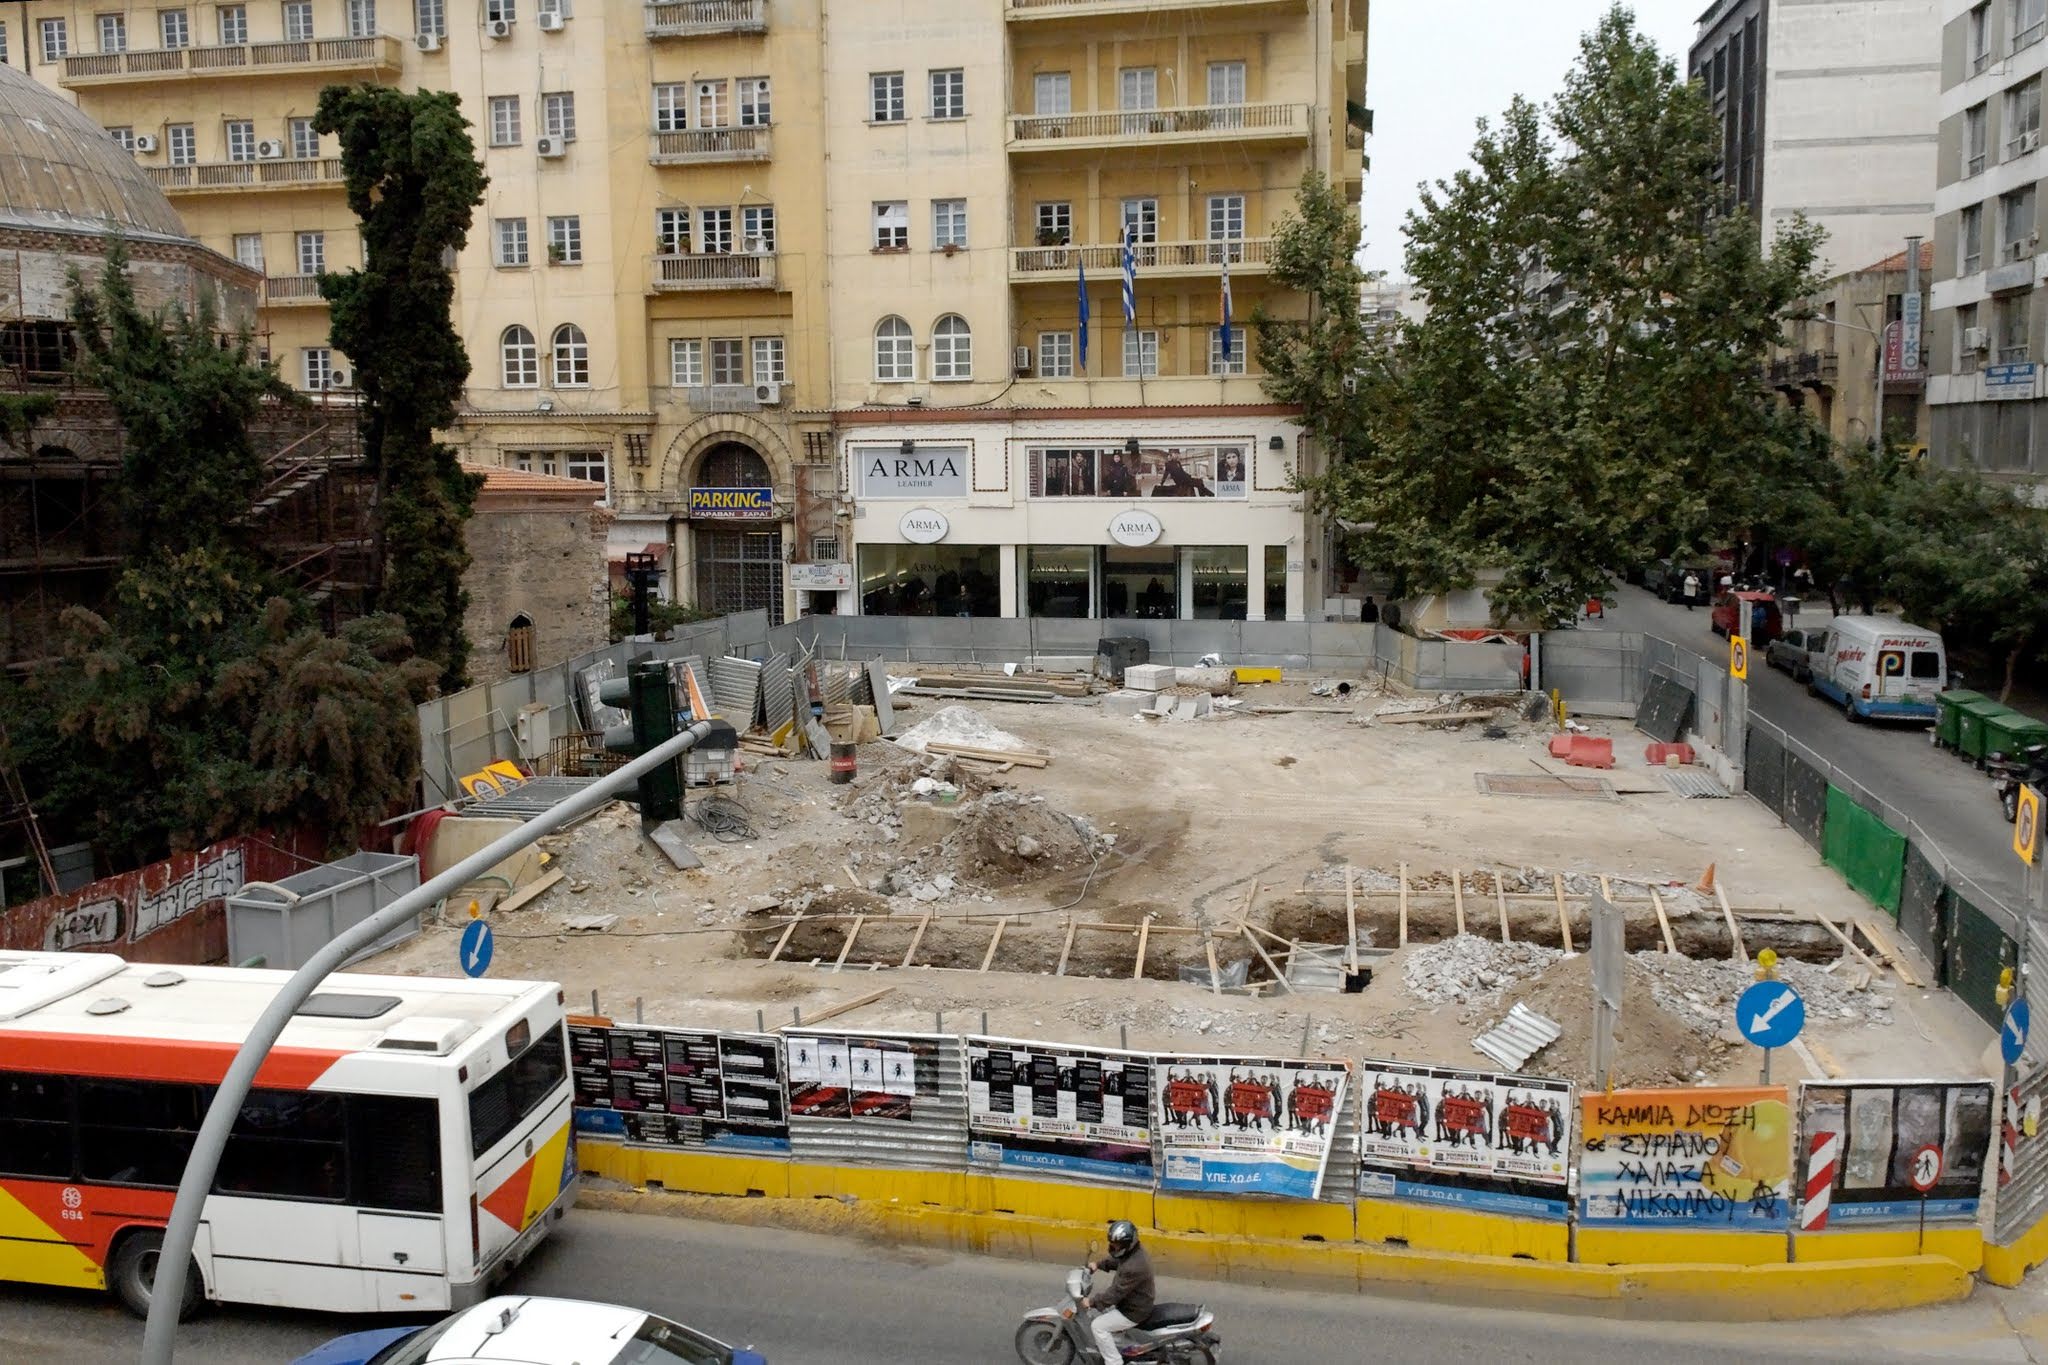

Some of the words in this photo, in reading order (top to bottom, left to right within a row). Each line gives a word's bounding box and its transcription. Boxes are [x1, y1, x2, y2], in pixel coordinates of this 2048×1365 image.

[1904, 297, 1920, 368] SEIKO
[868, 457, 959, 477] ARMA
[897, 480, 933, 488] LEATHER
[1221, 484, 1241, 492] ARMA
[692, 492, 761, 508] PARKING
[906, 519, 942, 530] ARMA
[1116, 522, 1154, 533] ARMA
[1882, 638, 1930, 648] painter
[1836, 644, 1867, 664] painter
[1598, 1105, 1674, 1126] ΚΑΜΜΙΑ
[1063, 1123, 1071, 1131] 14
[1197, 1134, 1205, 1142] 14
[1257, 1138, 1265, 1146] 14
[1619, 1131, 1733, 1158] ΣΥΡΙΑΝΟΥ
[1471, 1154, 1479, 1162] 14
[1532, 1163, 1541, 1171] 14
[1615, 1160, 1716, 1188] ΧΑΛΑΖΑ
[61, 1209, 84, 1220] 694
